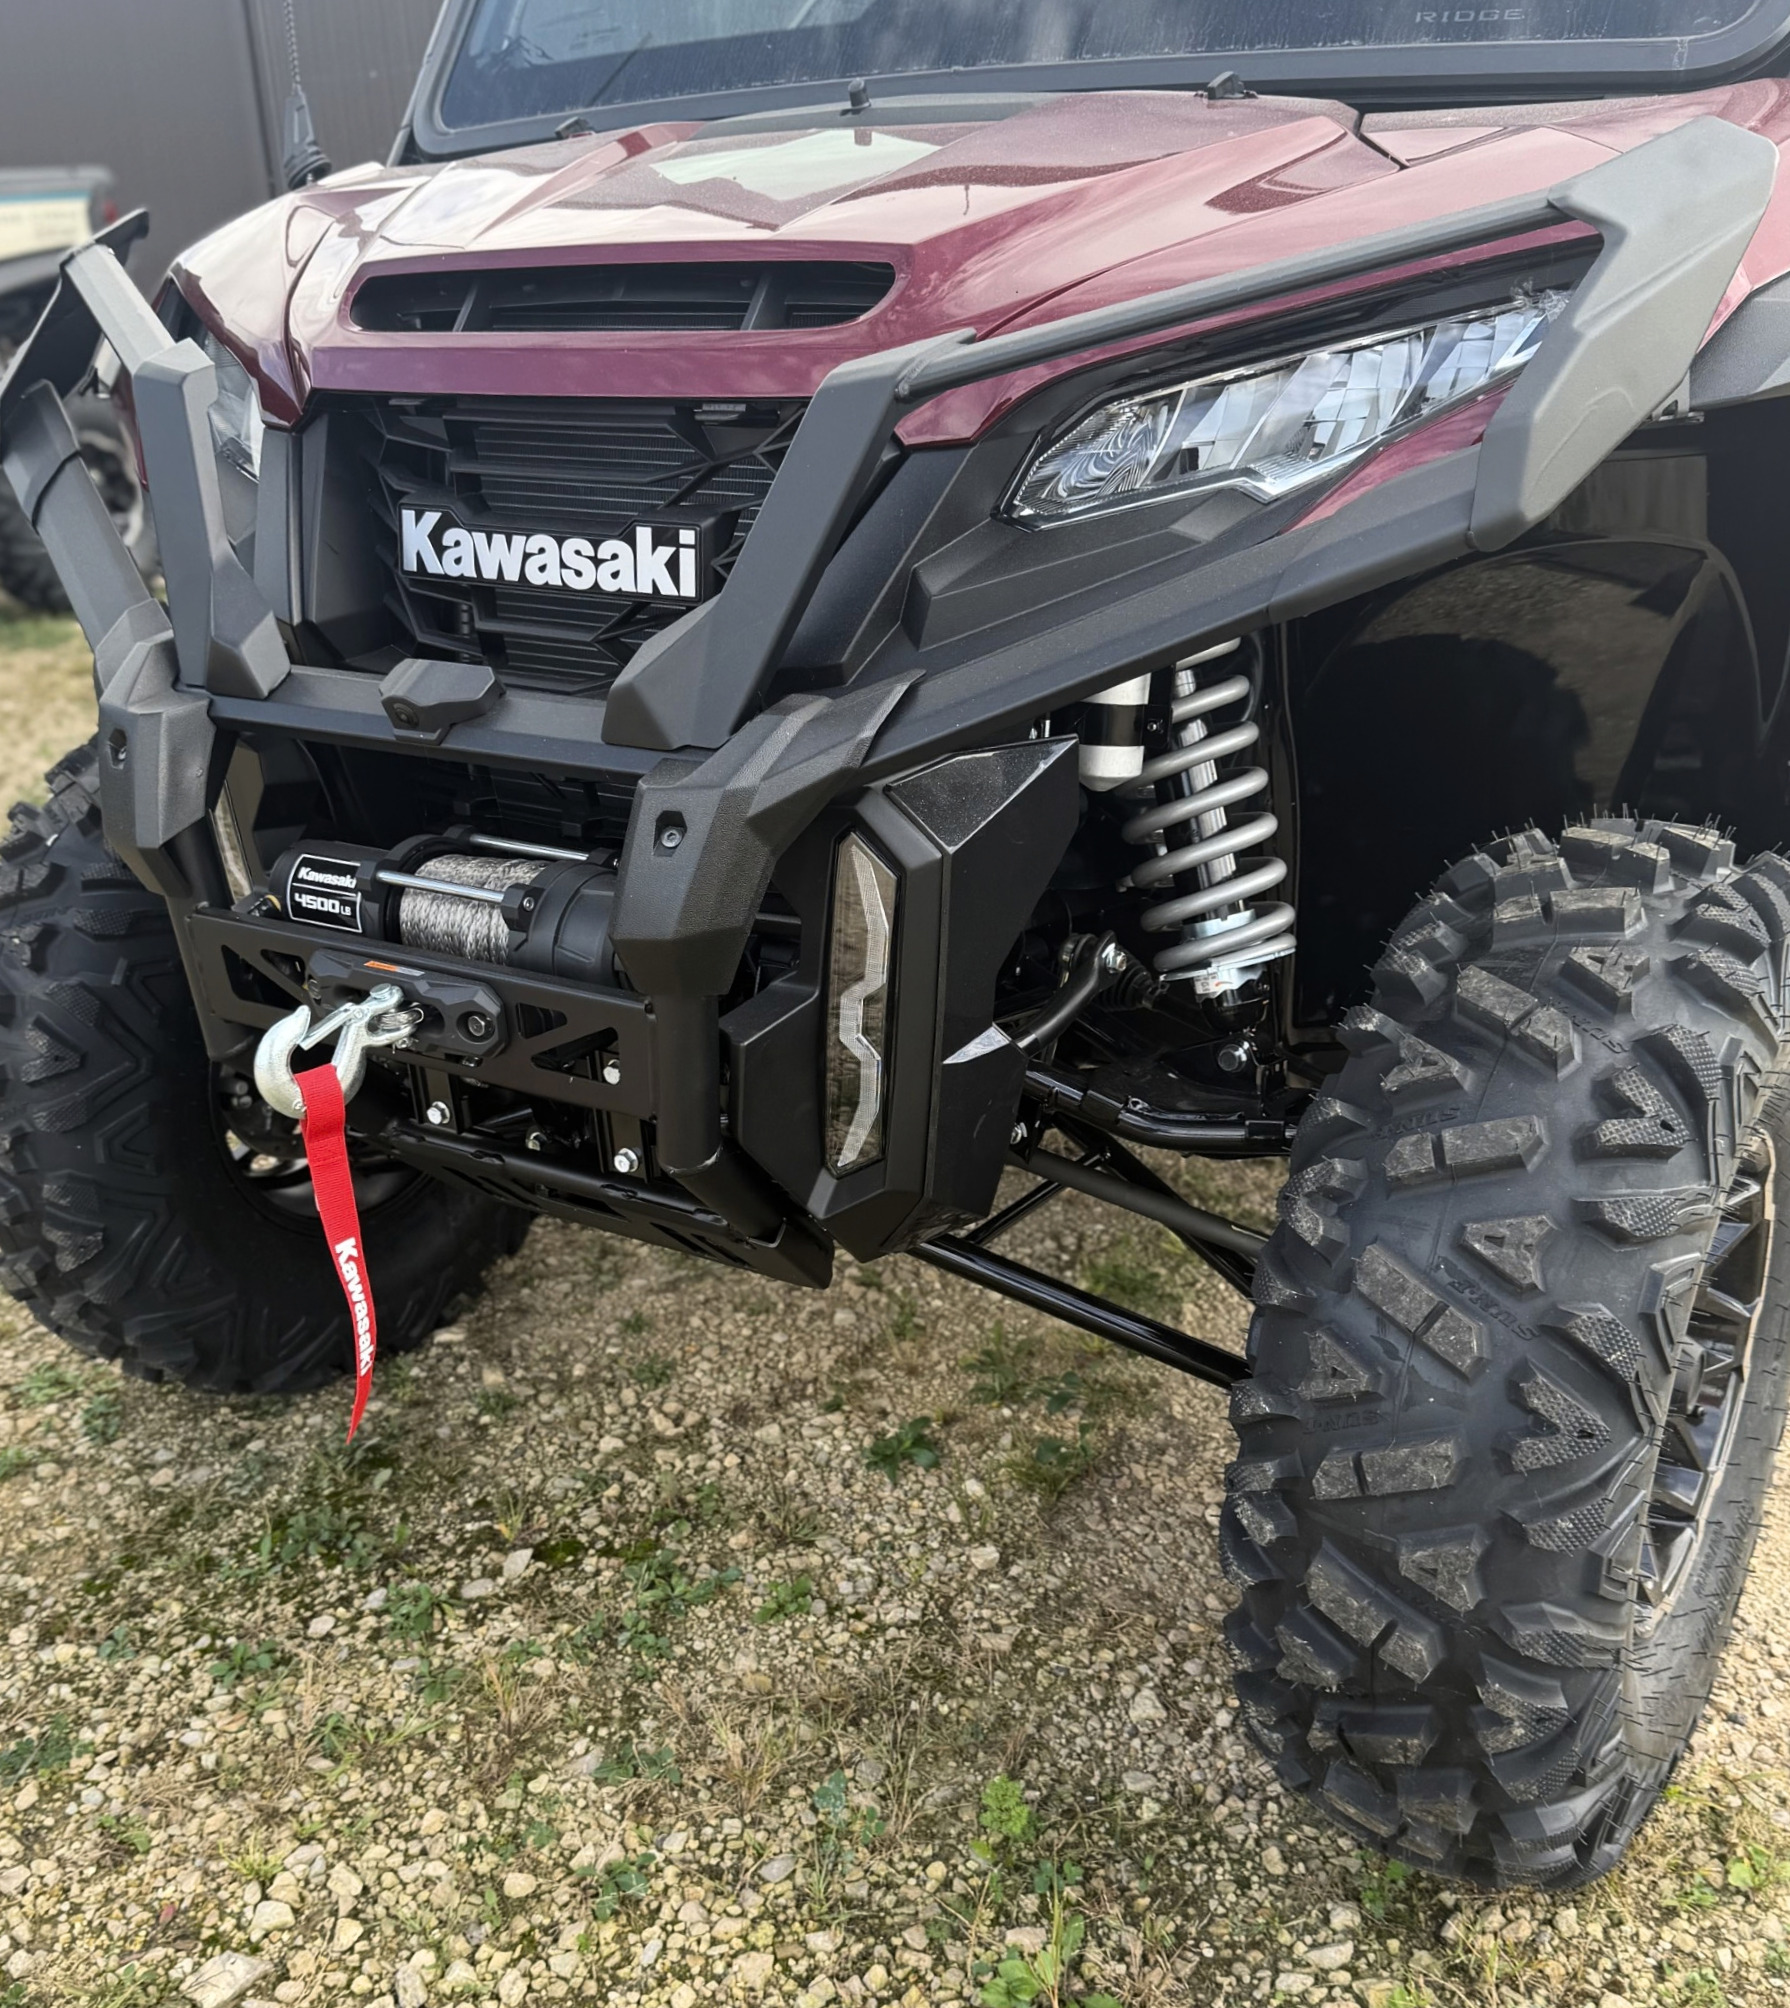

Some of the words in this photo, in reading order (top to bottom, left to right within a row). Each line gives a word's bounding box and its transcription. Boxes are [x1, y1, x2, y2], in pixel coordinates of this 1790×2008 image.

[1415, 8, 1523, 23] RIDGE
[401, 509, 696, 597] Kawasaki
[298, 866, 357, 889] Kawasaki
[294, 892, 340, 914] 4500
[340, 905, 352, 916] LB
[335, 1237, 375, 1377] Kawasaki
